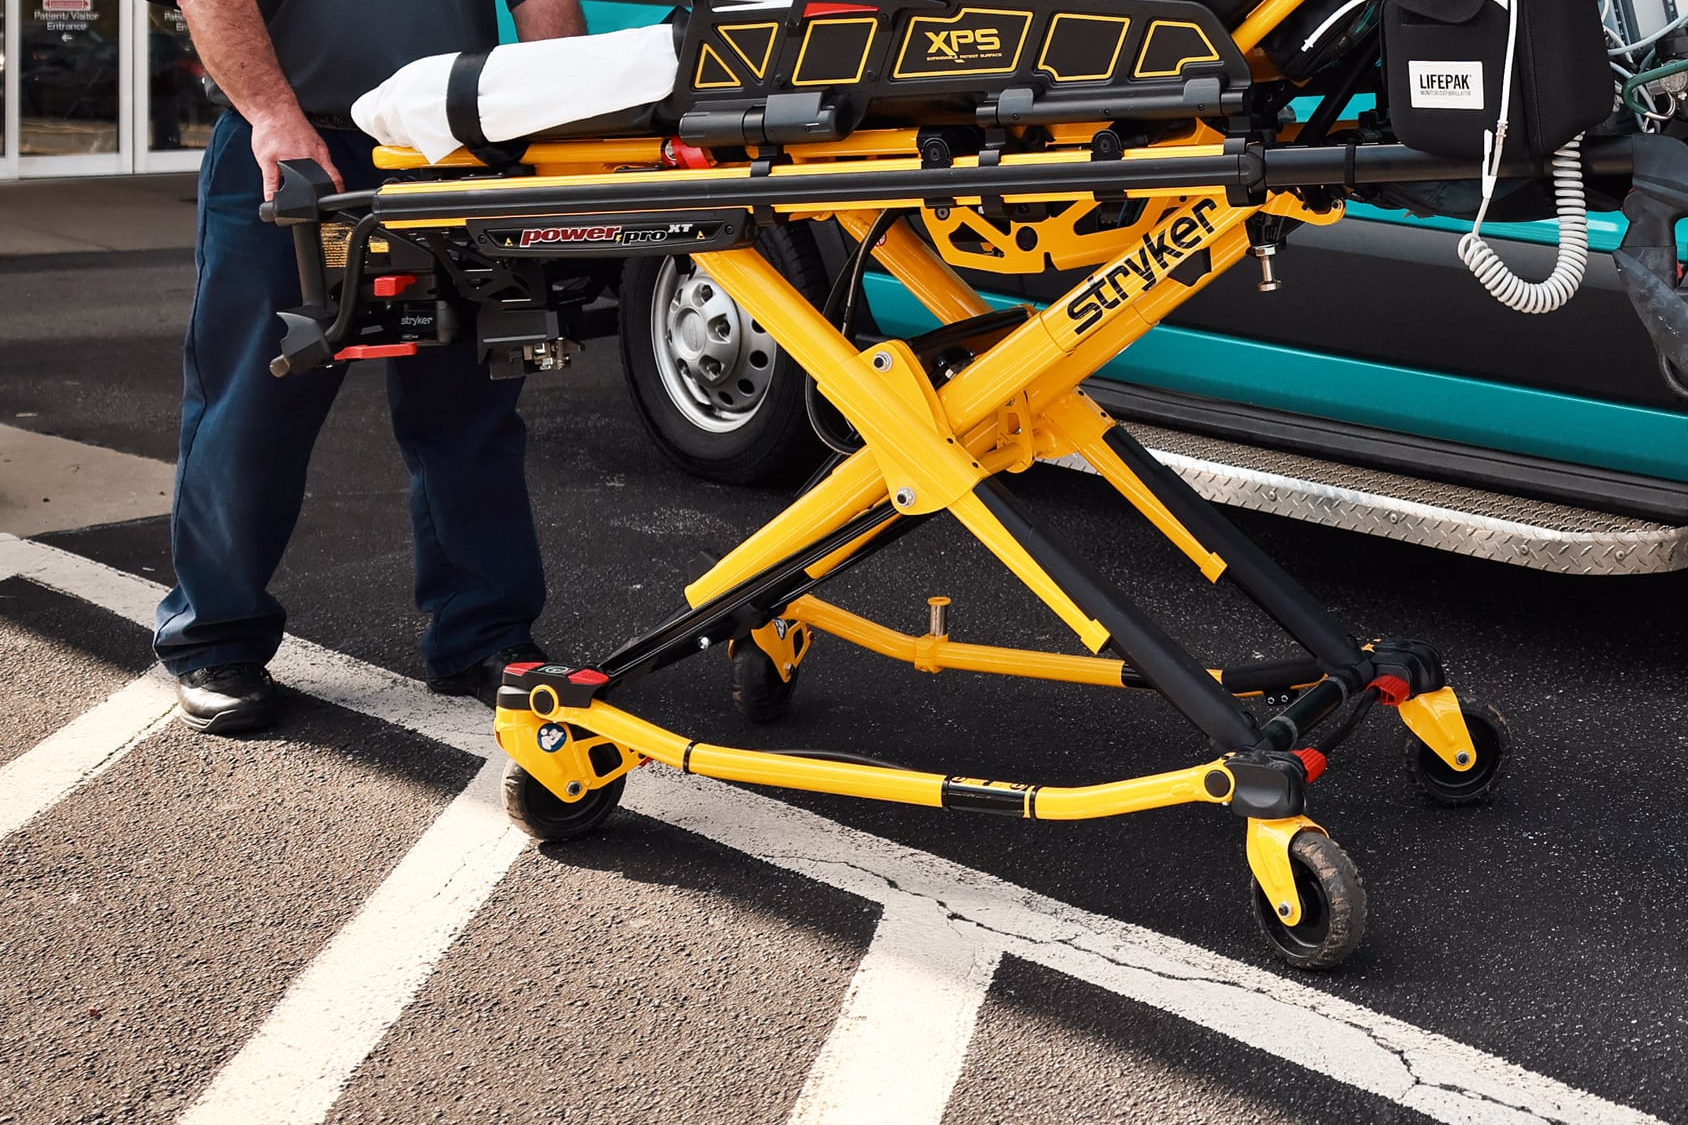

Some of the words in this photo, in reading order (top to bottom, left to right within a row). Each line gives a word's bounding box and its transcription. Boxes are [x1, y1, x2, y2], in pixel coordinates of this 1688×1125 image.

[46, 21, 88, 31] Entrance
[924, 28, 1001, 56] XPS
[1419, 73, 1471, 90] LIFEPAK
[667, 223, 693, 233] XT
[1067, 198, 1217, 335] stryker
[400, 315, 433, 326] stryker
